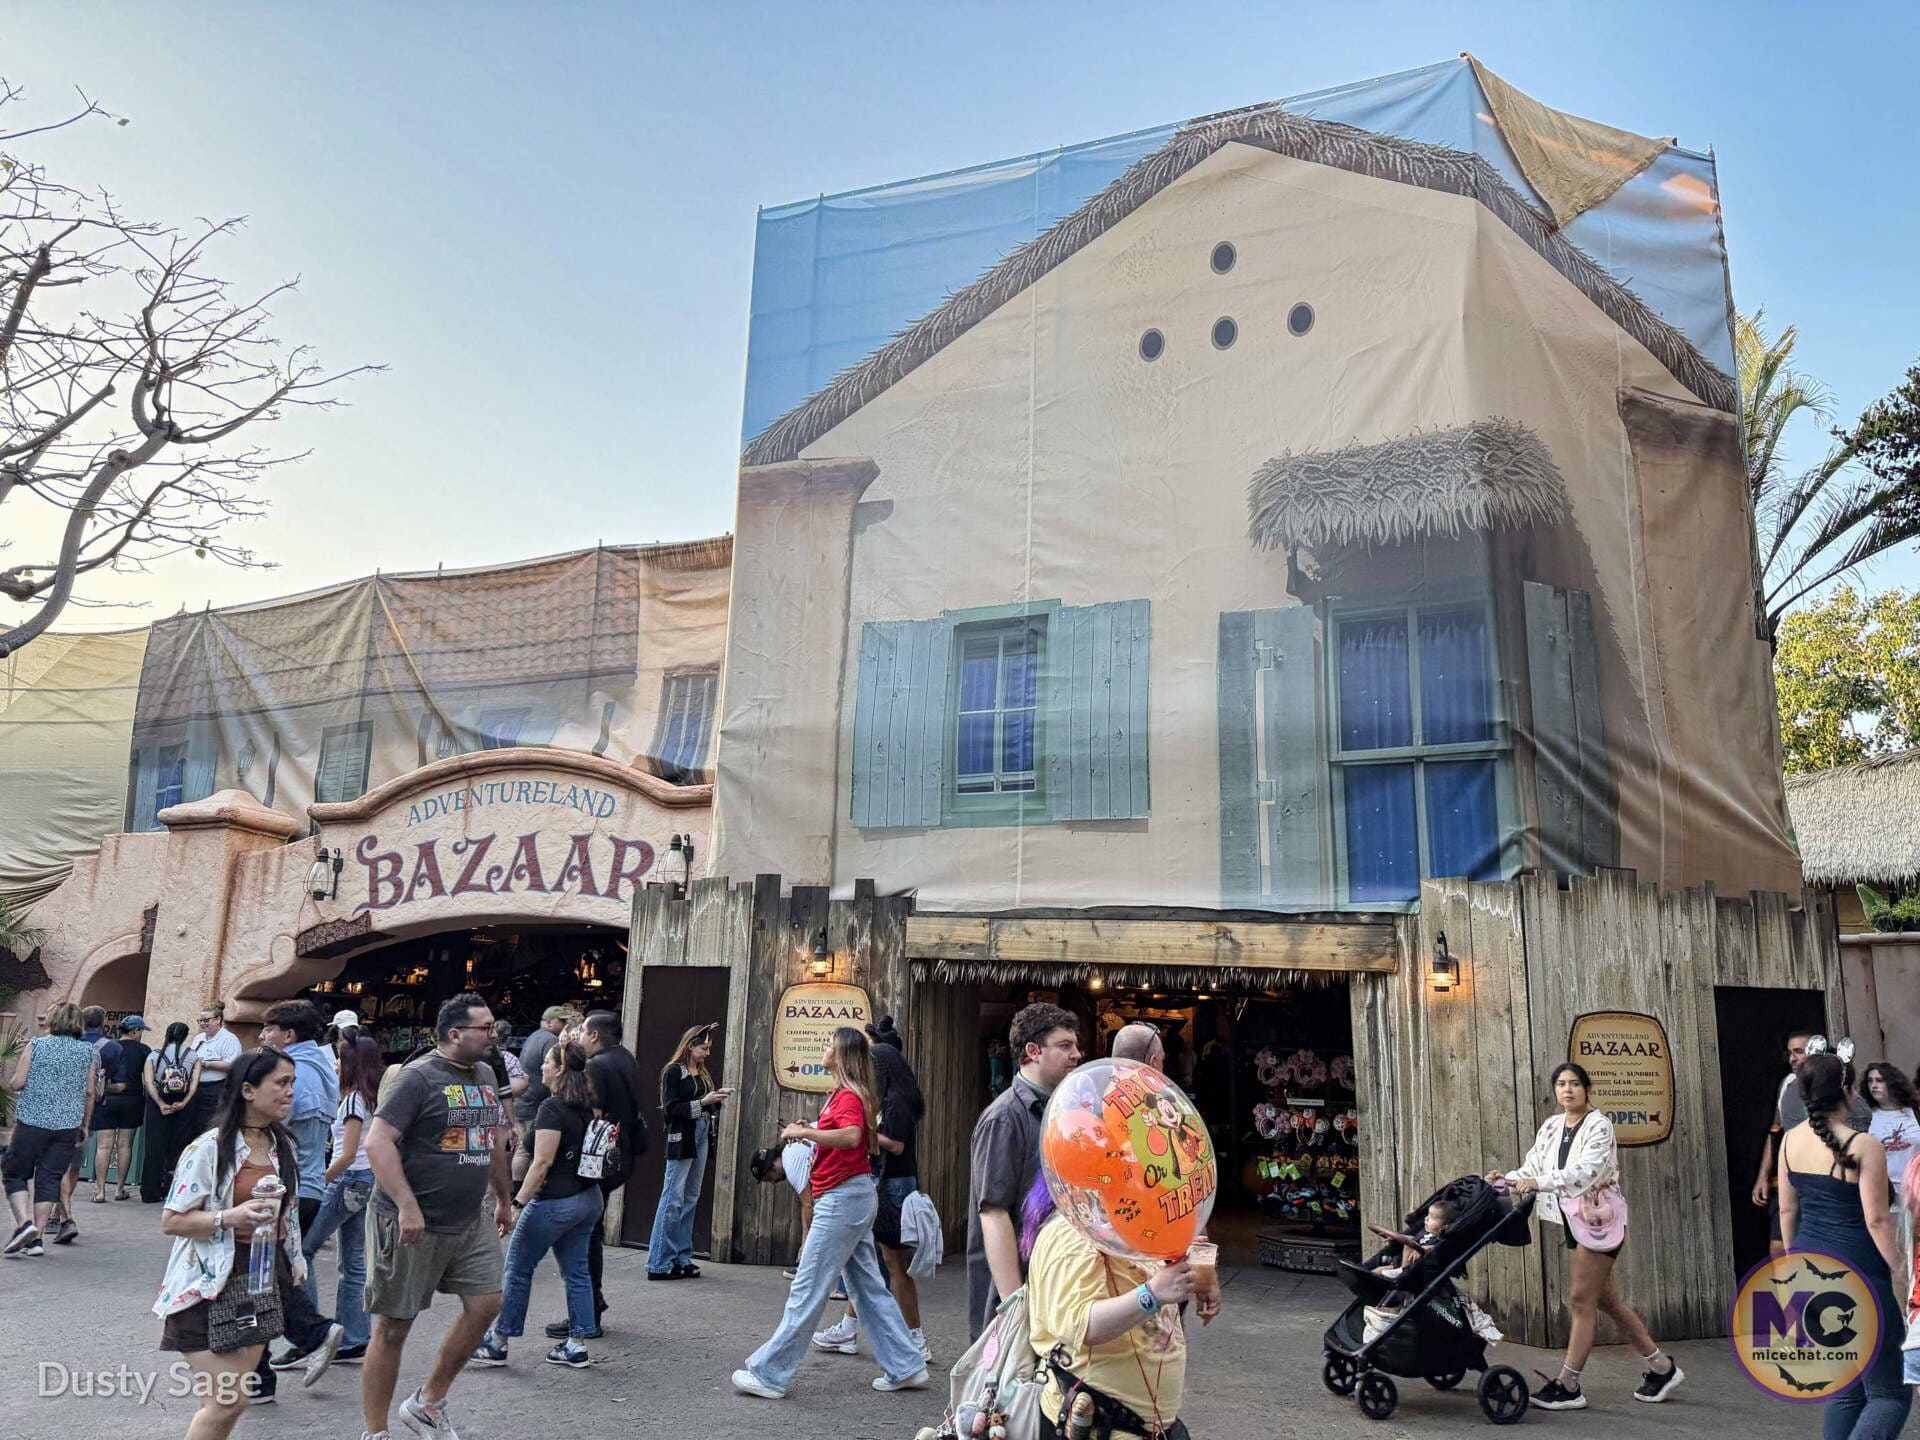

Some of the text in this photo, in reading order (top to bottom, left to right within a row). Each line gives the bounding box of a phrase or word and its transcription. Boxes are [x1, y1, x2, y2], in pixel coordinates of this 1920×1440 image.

[407, 781, 616, 827] ADVENTURELAND
[352, 831, 655, 916] BAZAAR
[785, 1006, 865, 1020] BAZAAR
[1580, 1041, 1663, 1058] BAZAAR
[1605, 1110, 1648, 1125] OPEN
[1144, 1164, 1167, 1189] Or
